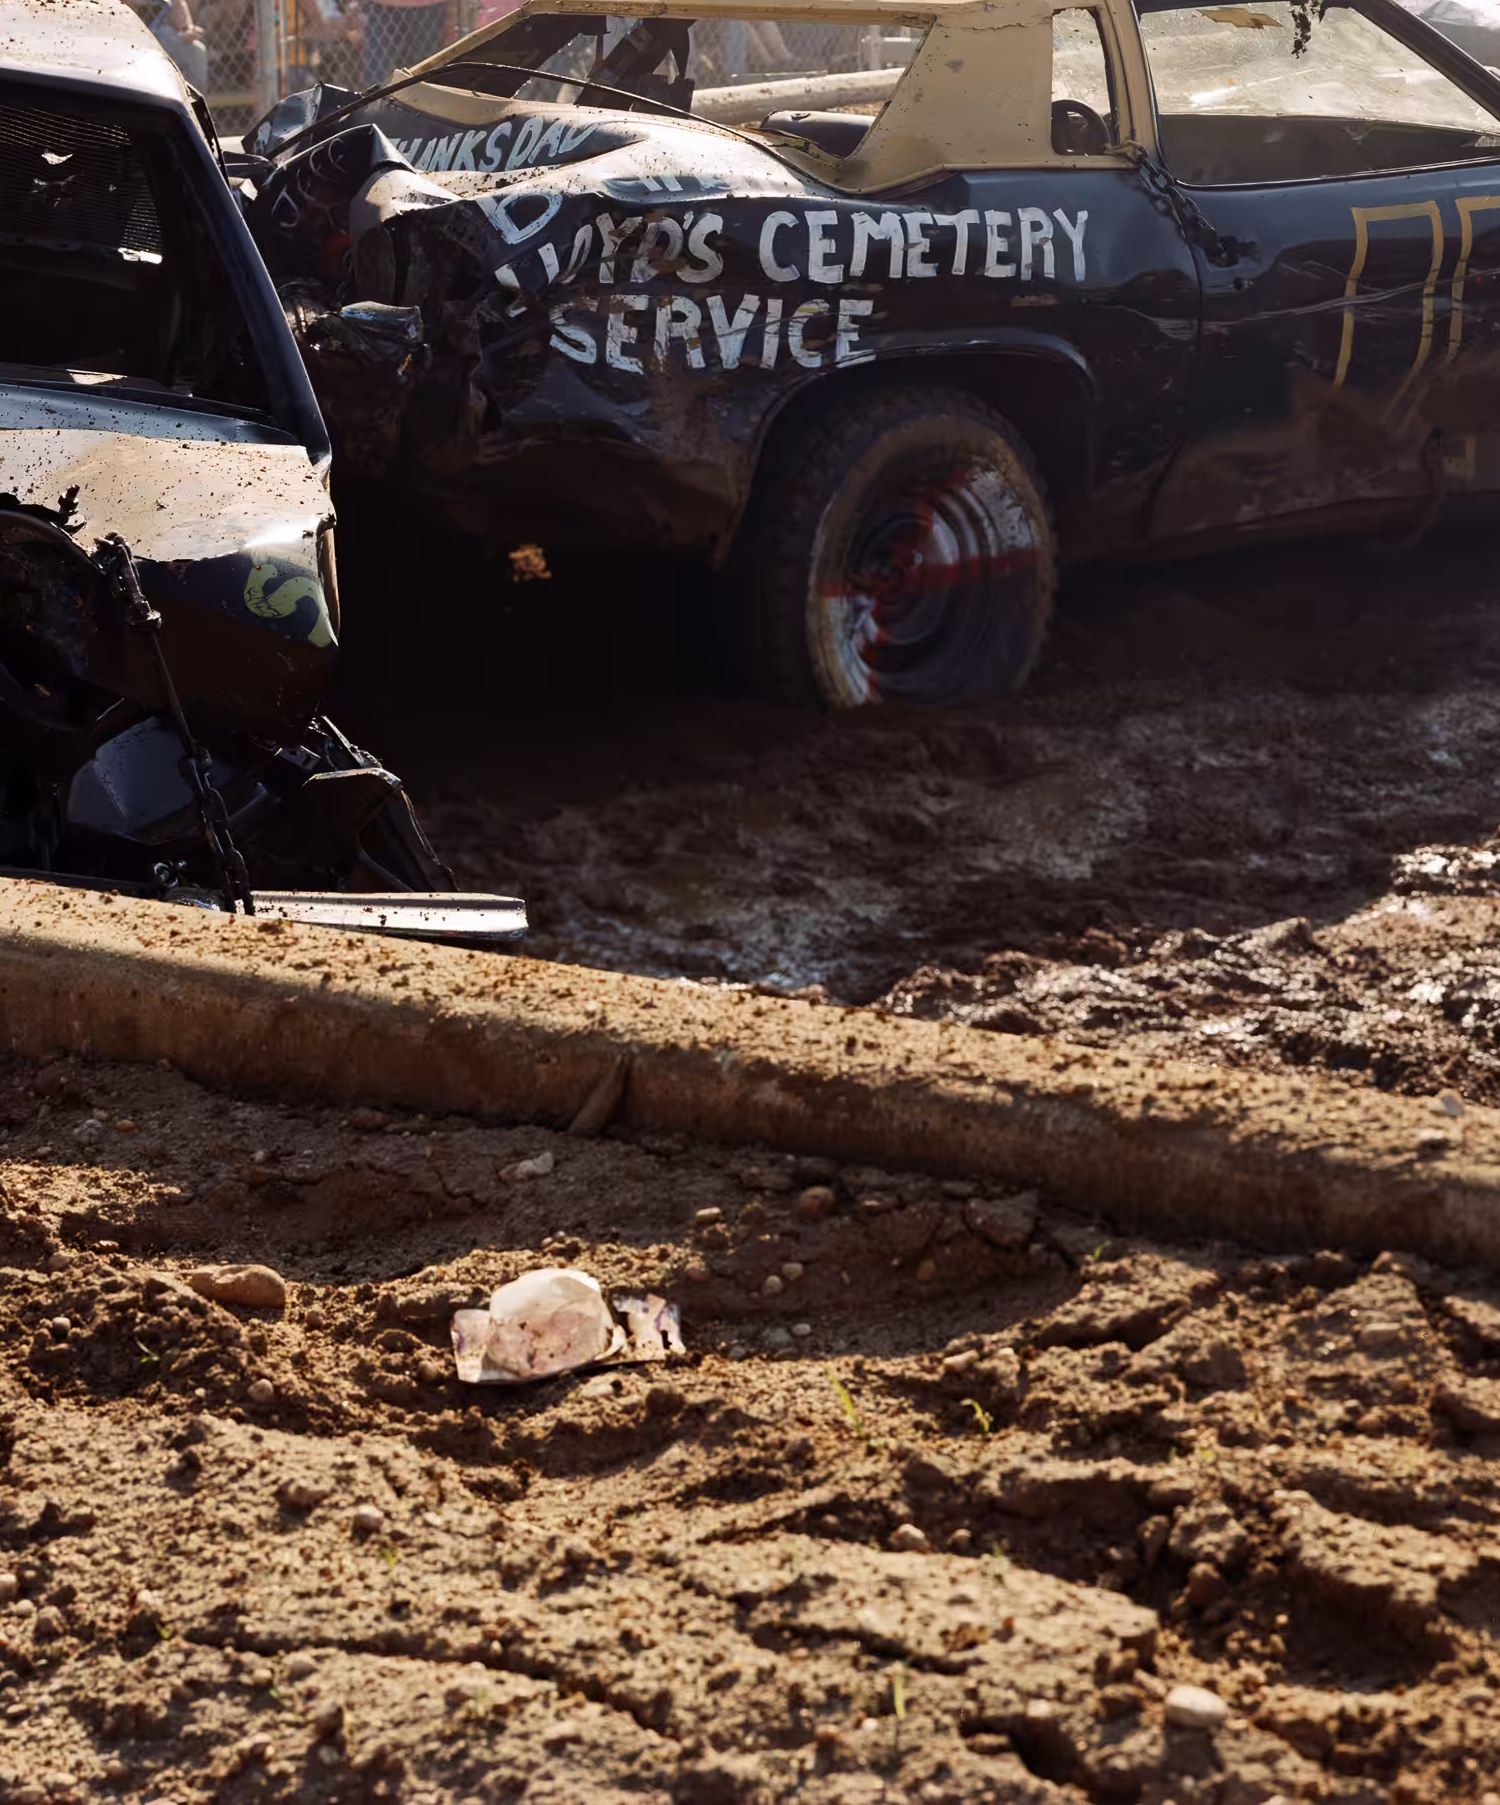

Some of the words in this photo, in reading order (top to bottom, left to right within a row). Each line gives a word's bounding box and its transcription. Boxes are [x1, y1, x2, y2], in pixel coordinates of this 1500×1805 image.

[386, 121, 512, 173] THANKS
[759, 207, 1088, 283] CEMETERY
[549, 293, 876, 375] SERVICE
